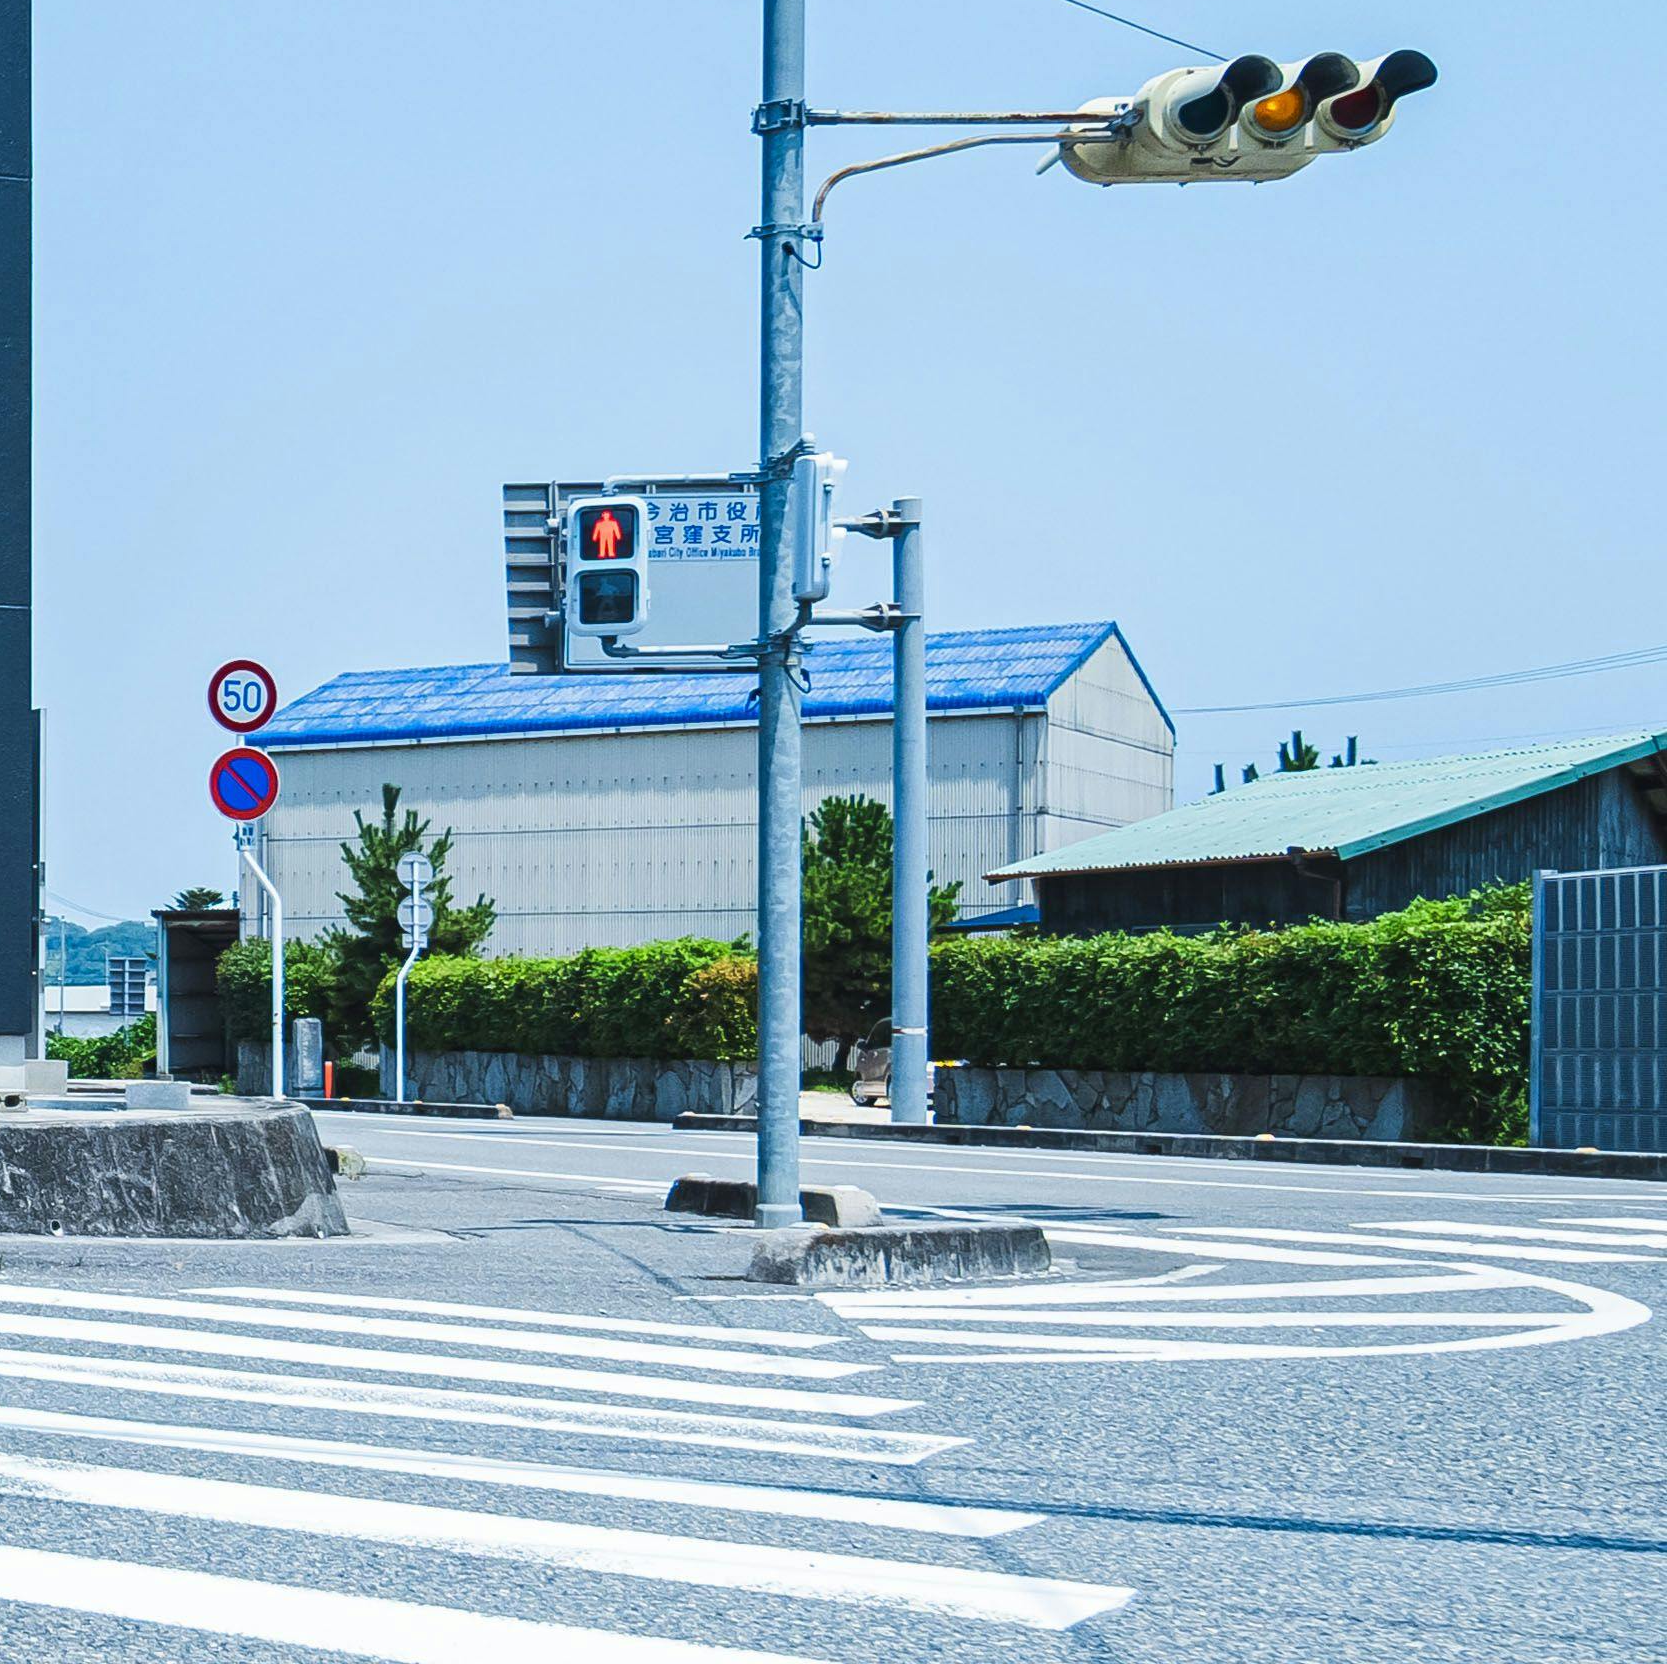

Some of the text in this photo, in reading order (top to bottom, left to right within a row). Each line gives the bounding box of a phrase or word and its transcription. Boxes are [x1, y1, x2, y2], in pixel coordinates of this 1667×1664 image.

[647, 501, 760, 522] 今治市役
[654, 524, 761, 545] 宮窪支所
[223, 680, 262, 713] 50
